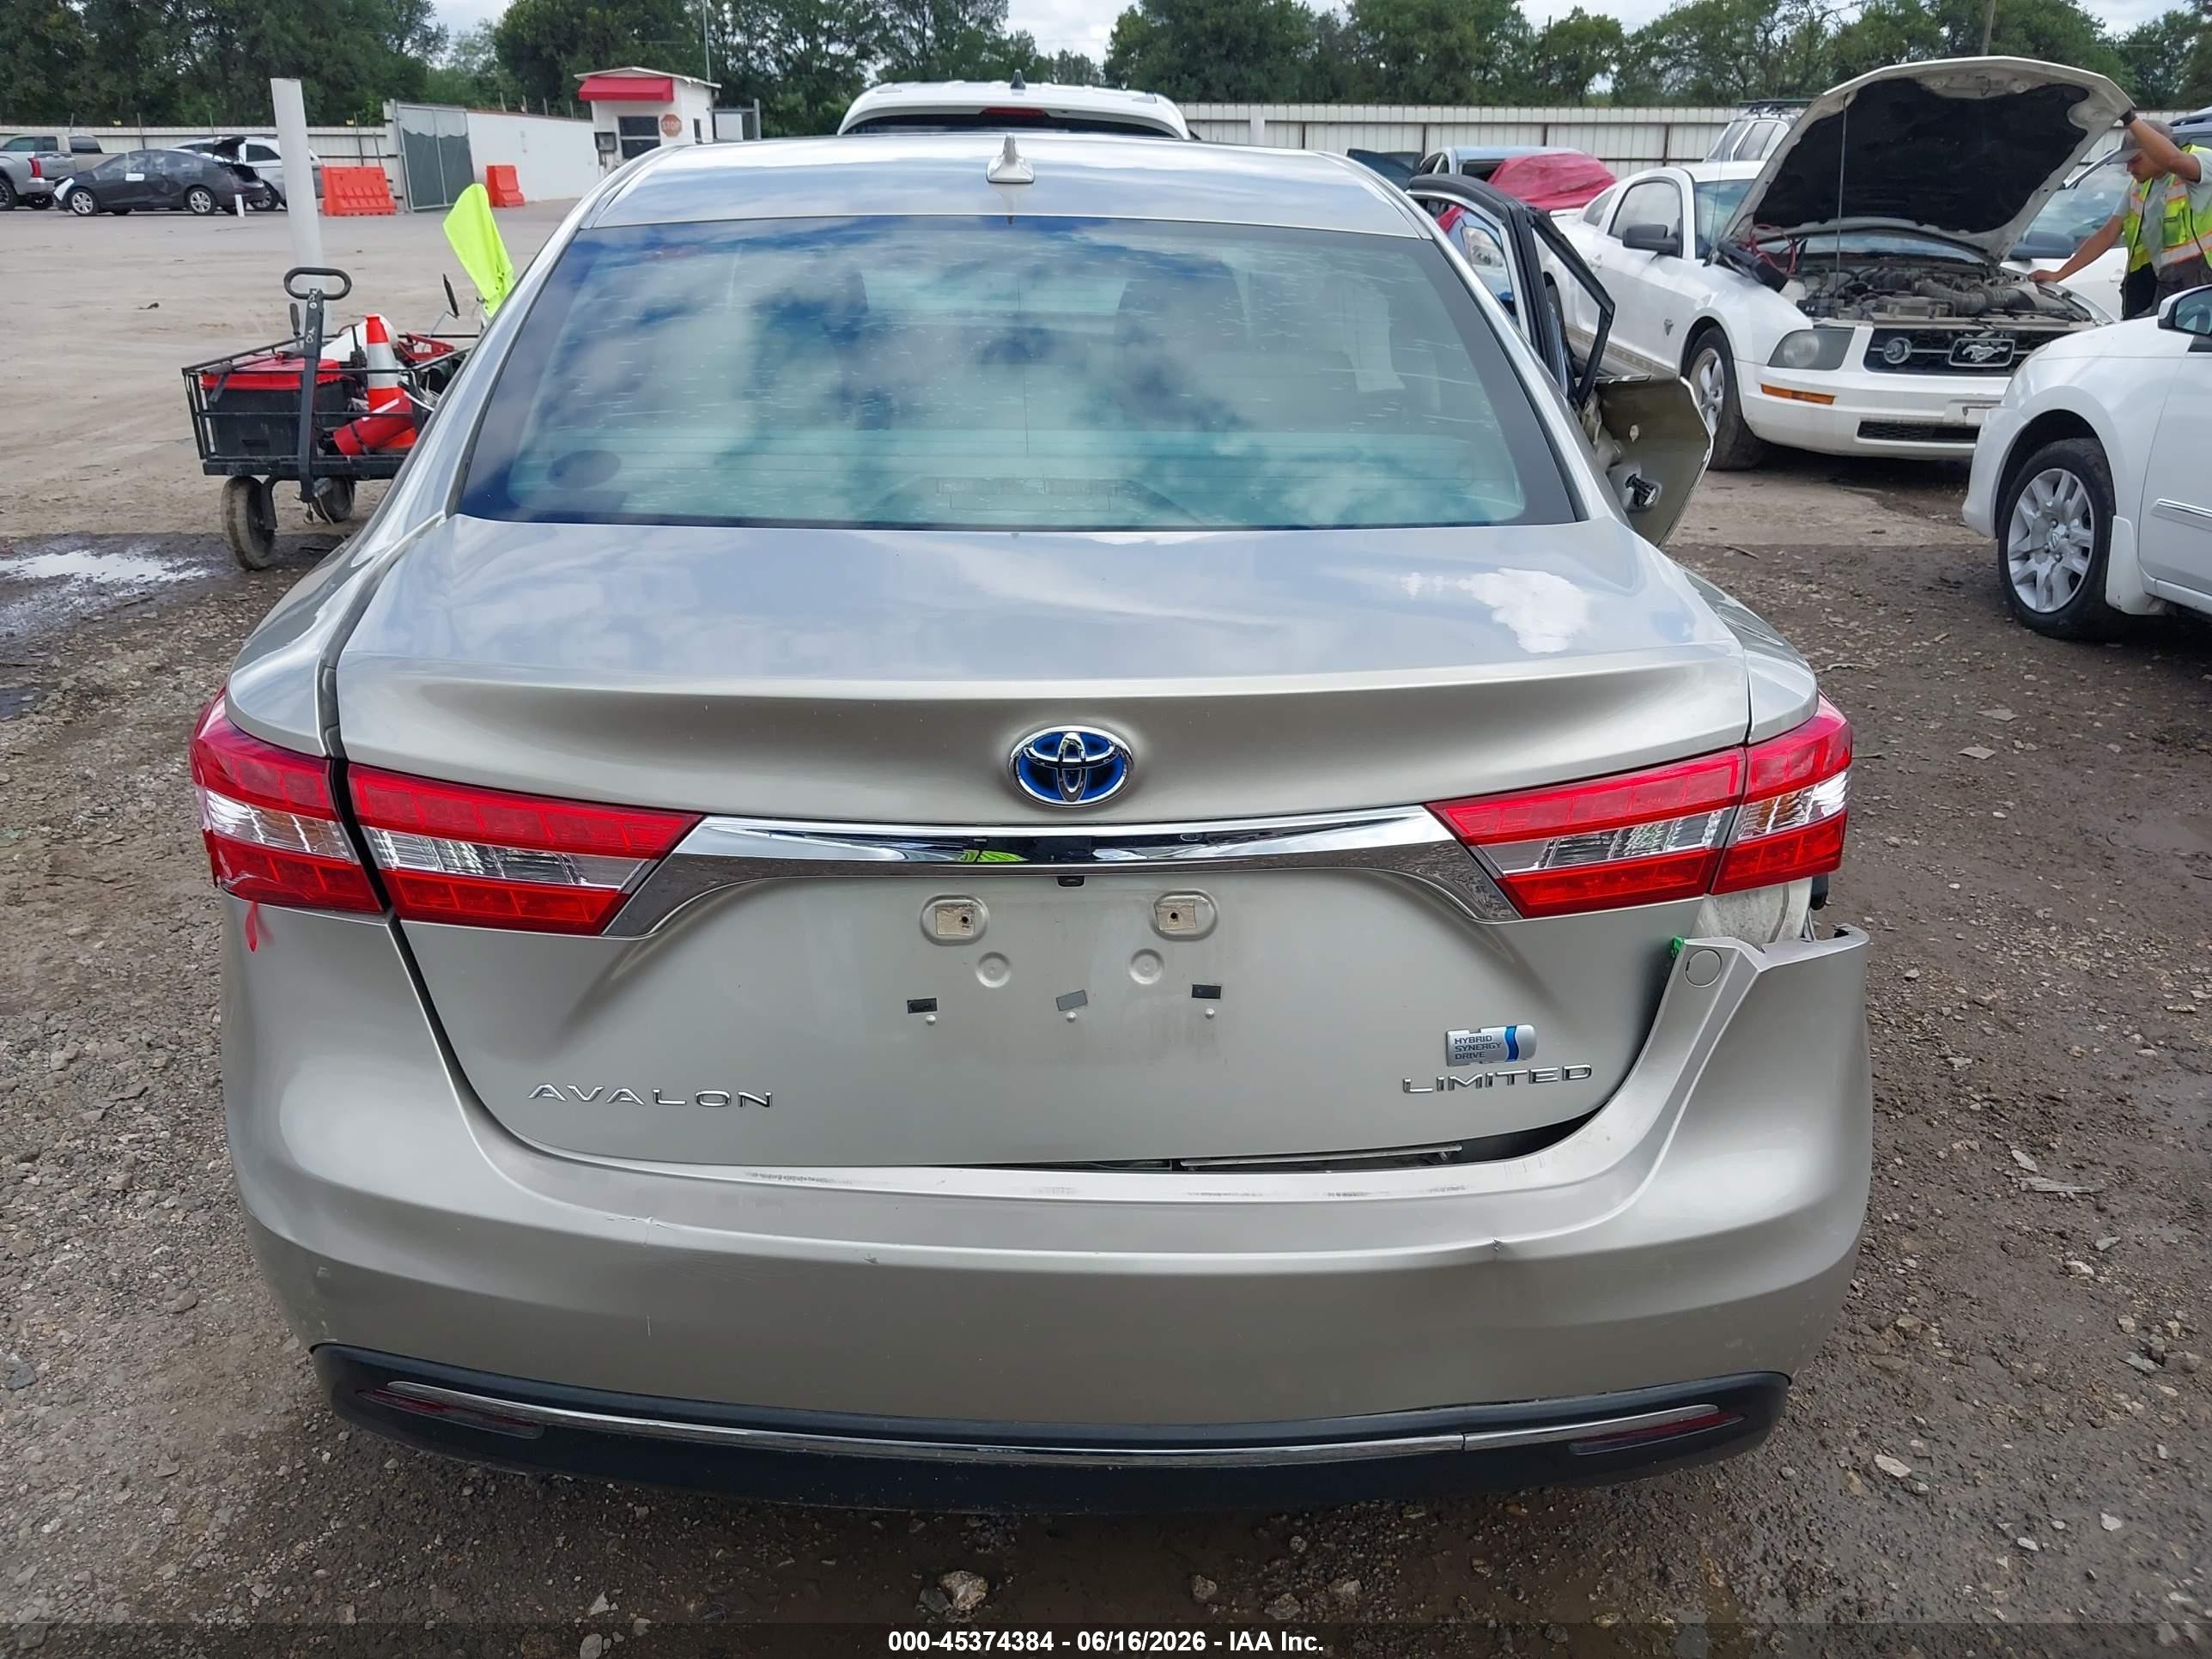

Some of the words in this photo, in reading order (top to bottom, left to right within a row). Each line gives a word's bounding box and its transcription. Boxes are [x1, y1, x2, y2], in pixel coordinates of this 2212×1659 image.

[1455, 1035, 1492, 1045] HYBRID
[1455, 1042, 1502, 1053] SYNERGY
[1455, 1051, 1486, 1060] DRIVE
[1402, 1063, 1593, 1094] LIMITED
[527, 1083, 774, 1109] AVALON
